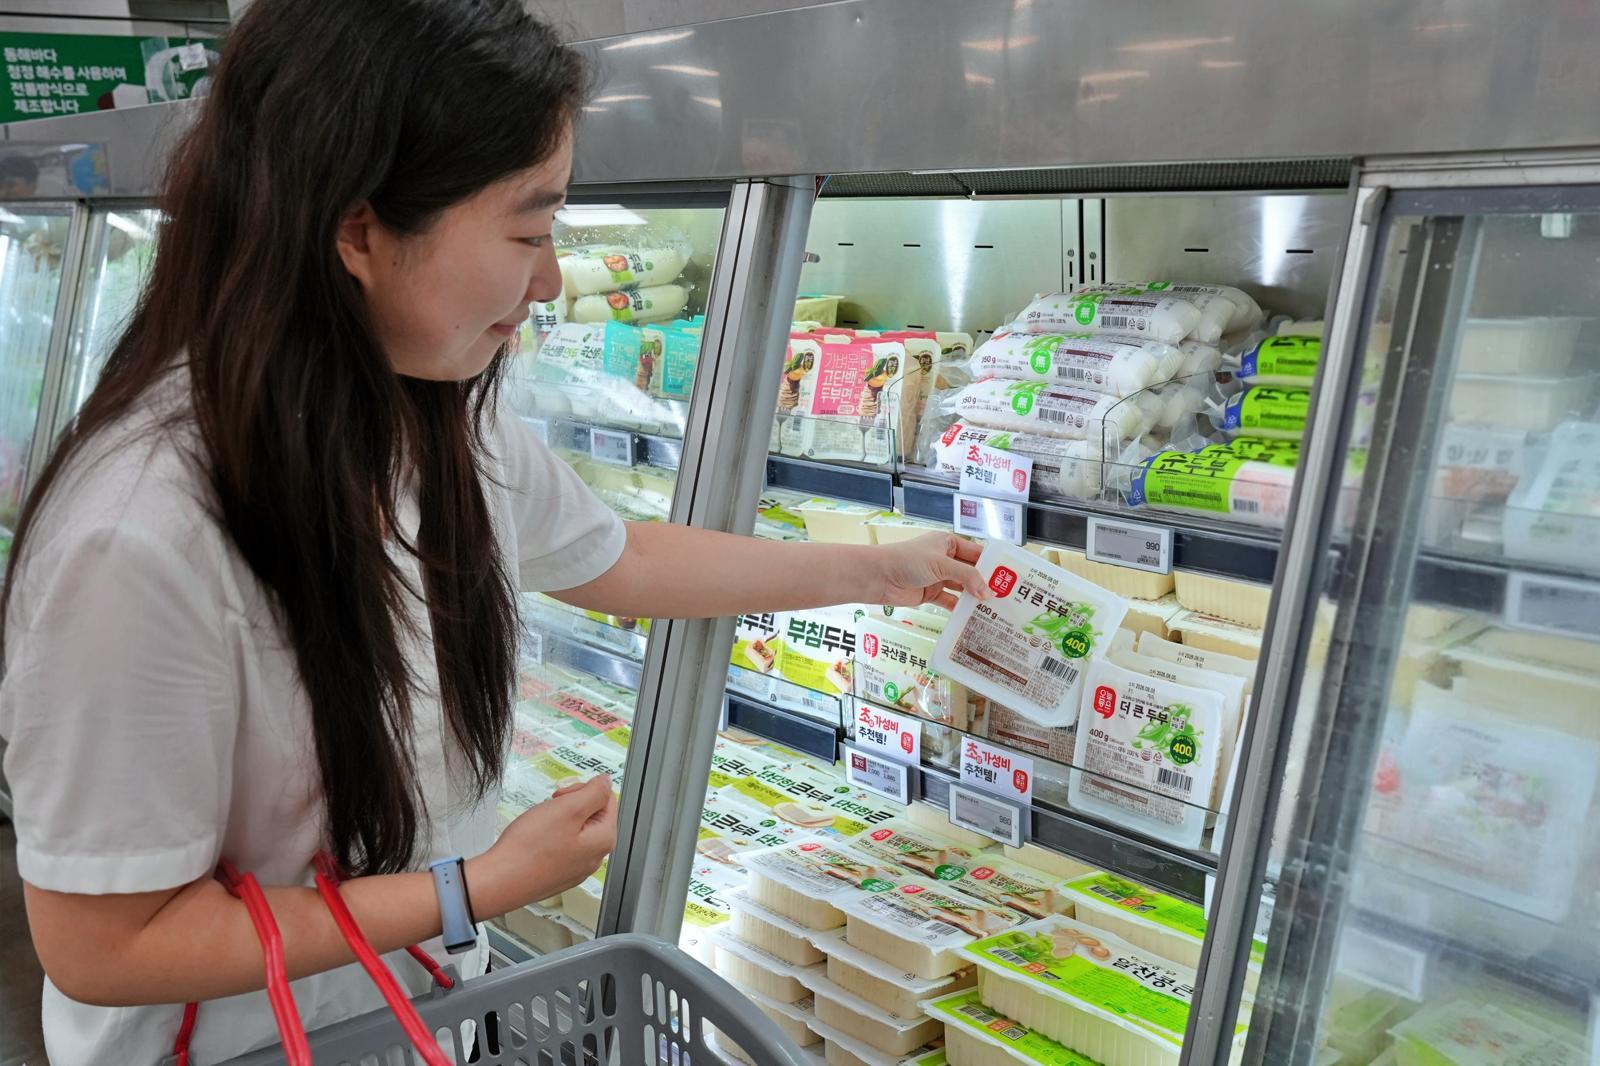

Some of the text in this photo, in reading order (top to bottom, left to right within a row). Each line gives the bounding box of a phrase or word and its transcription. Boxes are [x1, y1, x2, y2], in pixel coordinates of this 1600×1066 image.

[77, 66, 127, 80] 사용하여
[14, 99, 79, 113] 제조합니다
[822, 369, 858, 387] 고단백
[960, 431, 988, 443] 순두부
[1156, 453, 1229, 478] 순두부
[1145, 541, 1160, 551] 990
[999, 569, 1014, 583] 오늘
[1018, 585, 1069, 618] 더 큰 두부
[976, 603, 998, 620] 400 g
[736, 613, 775, 635] 두부
[787, 617, 856, 657] 부침두부
[881, 644, 908, 664] 국산콩
[909, 655, 927, 670] 두부
[1119, 700, 1131, 715] 더
[1133, 704, 1144, 719] 큰
[1146, 708, 1169, 726] 두부
[859, 726, 887, 746] 추천템!
[1089, 728, 1109, 742] 400 g
[757, 770, 796, 788] 단단한
[965, 762, 998, 784] 추천템!
[831, 799, 873, 818] 단단한
[710, 814, 760, 837] 큰두부
